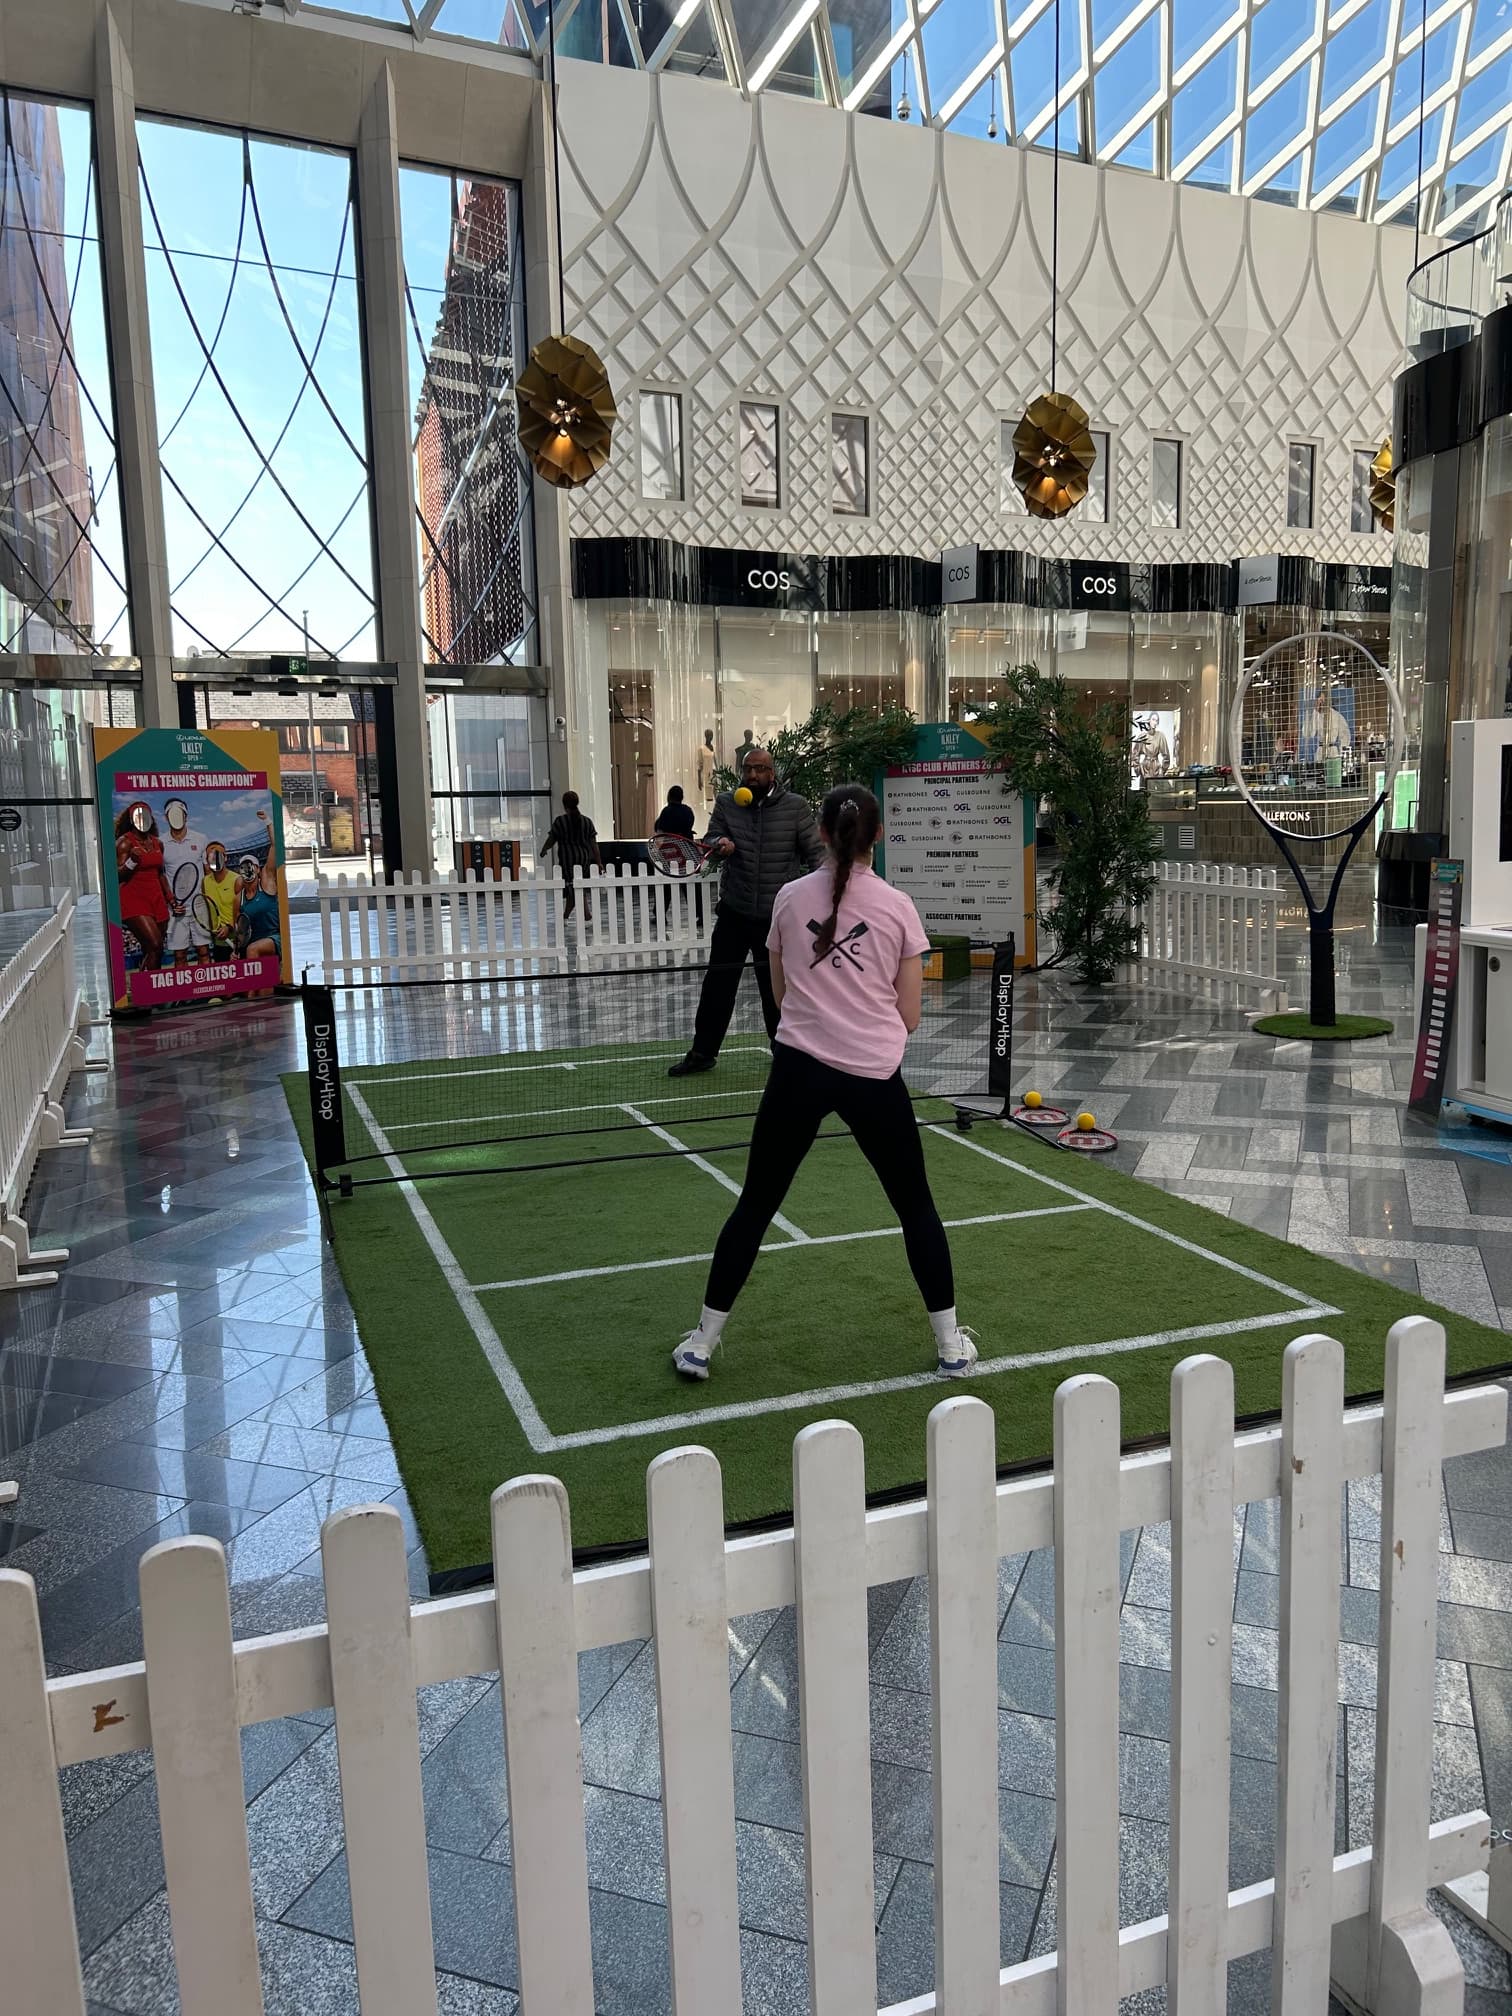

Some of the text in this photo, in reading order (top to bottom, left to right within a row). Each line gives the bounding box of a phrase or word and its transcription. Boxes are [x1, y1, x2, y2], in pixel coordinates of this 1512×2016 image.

[748, 569, 790, 591] COS
[948, 567, 970, 582] COS
[1082, 576, 1117, 595] COS
[181, 742, 203, 754] ILKLEY
[923, 762, 942, 773] CLUB
[943, 760, 981, 772] PARTNERS
[151, 775, 158, 788] A
[160, 775, 197, 788] TENNIS
[924, 776, 979, 785] PRINCIPAL PARTNERS
[933, 789, 951, 797] OGL
[953, 803, 971, 811] OGL
[993, 816, 1011, 825] OGL
[889, 834, 906, 842] OGL
[954, 913, 981, 921] PARTNERS
[850, 943, 861, 955] C
[832, 956, 842, 969] C
[150, 972, 174, 988] TAG
[176, 970, 192, 985] US
[995, 974, 1013, 1057] Display4top
[313, 1024, 336, 1120] Display4top
